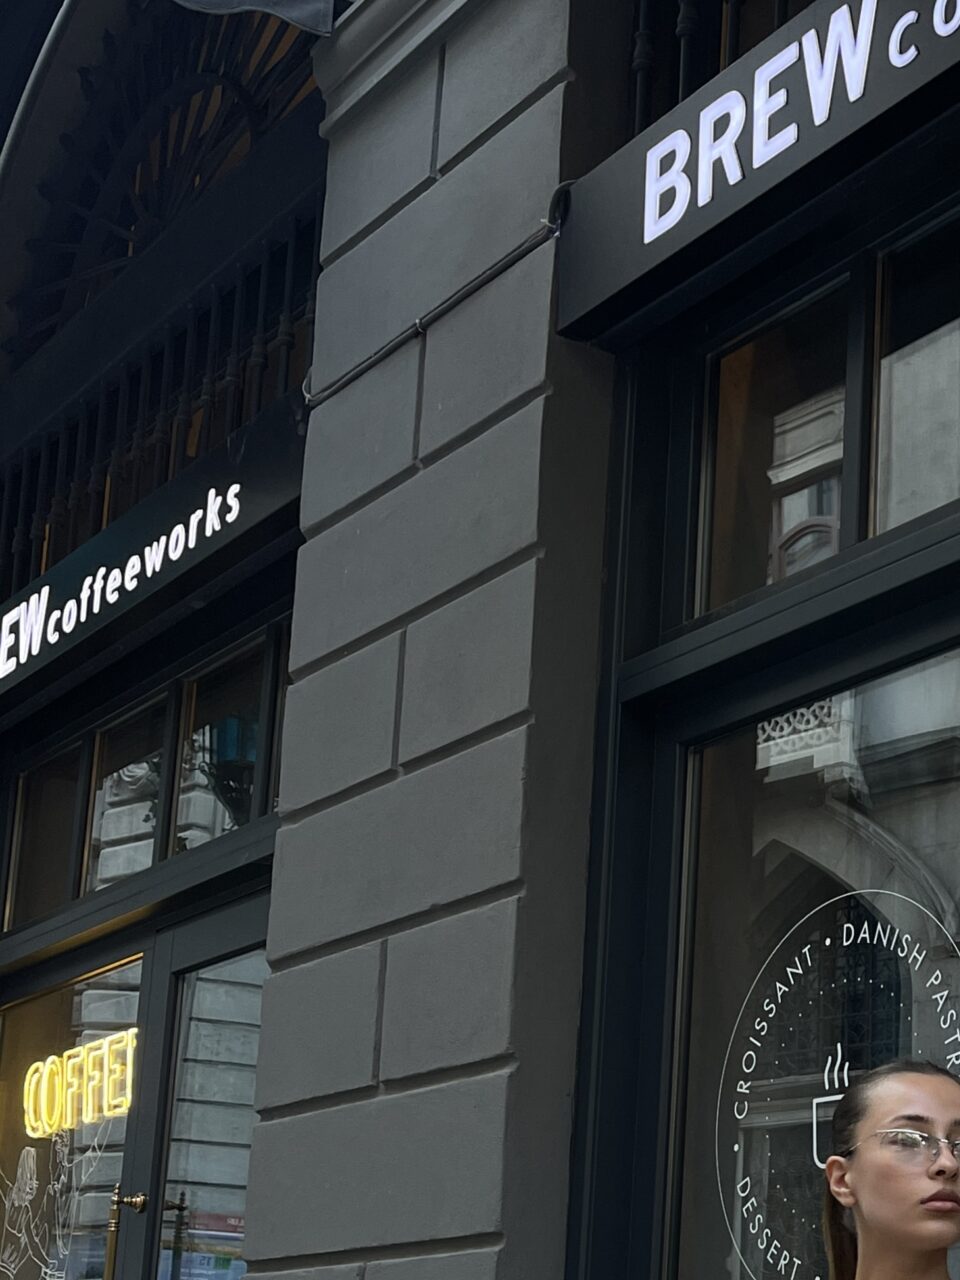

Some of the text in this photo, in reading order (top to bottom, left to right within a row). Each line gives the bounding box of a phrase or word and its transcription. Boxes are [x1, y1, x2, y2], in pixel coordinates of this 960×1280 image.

[643, 0, 878, 245] BREW
[734, 944, 811, 1119] CROISSANT
[843, 920, 926, 971] DANISH
[736, 1176, 802, 1280] DESSERT
